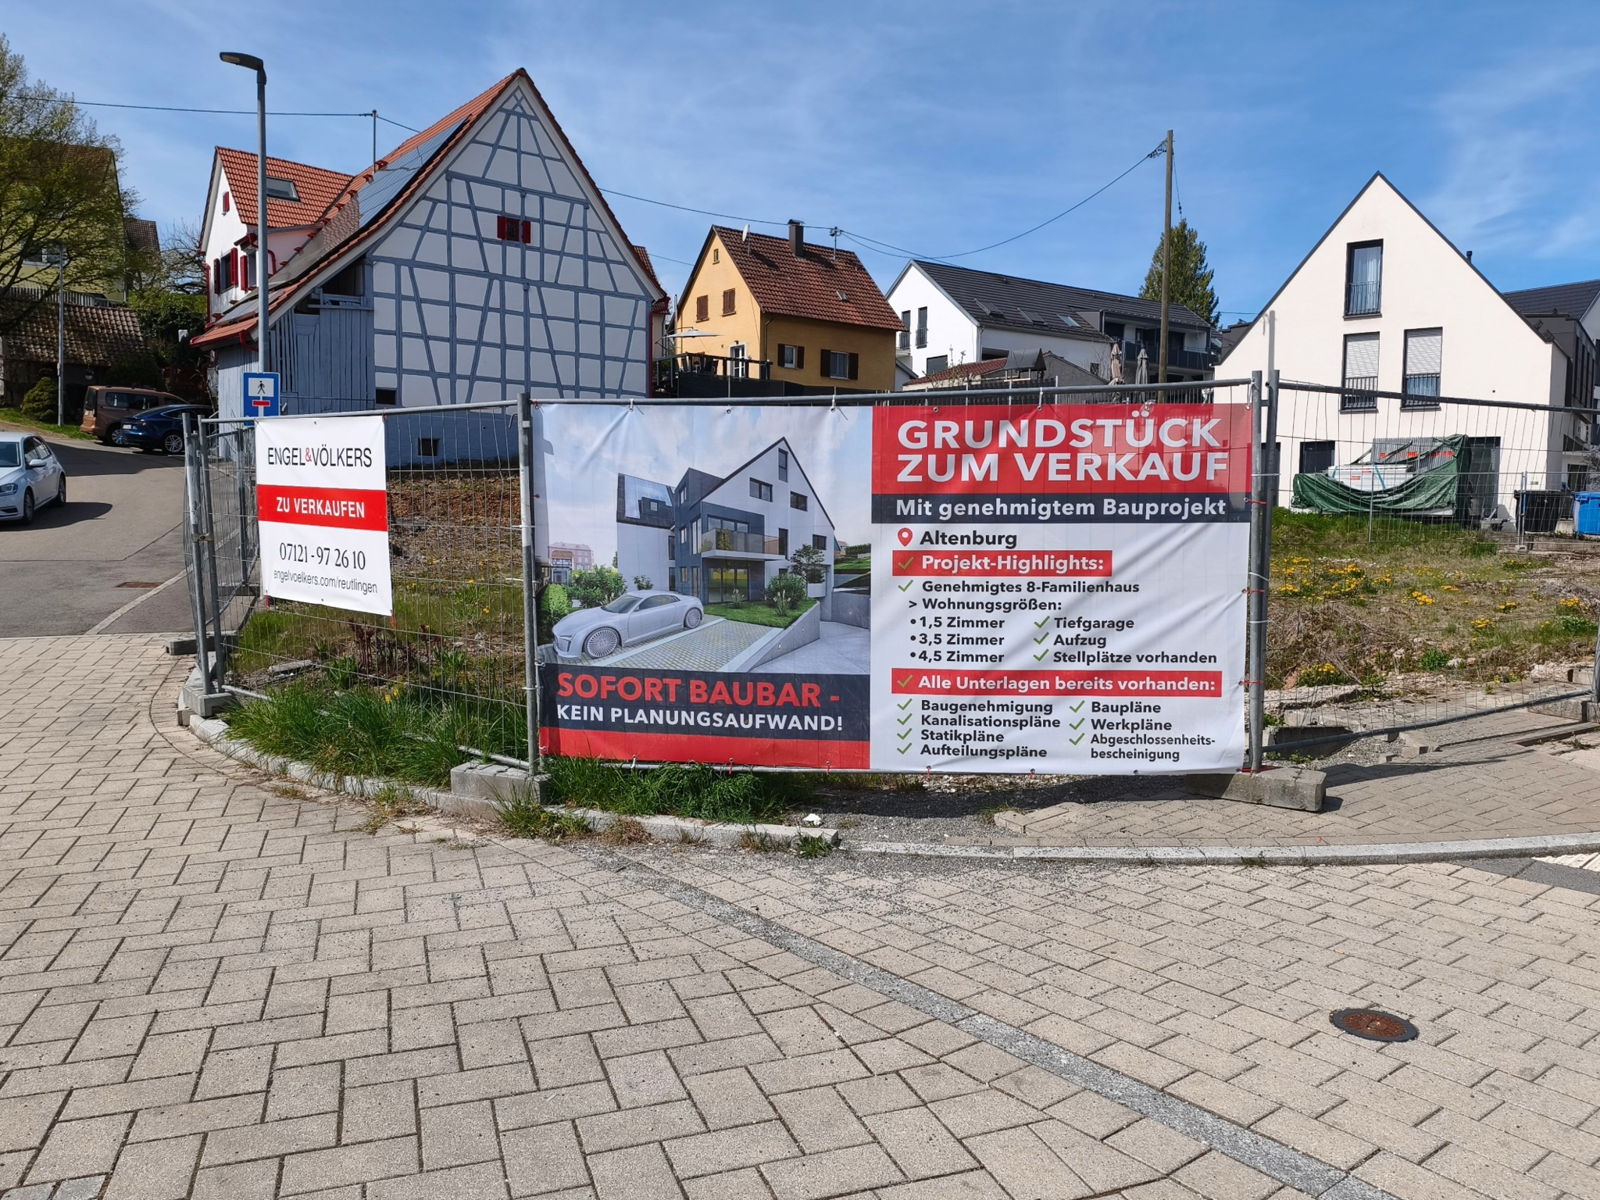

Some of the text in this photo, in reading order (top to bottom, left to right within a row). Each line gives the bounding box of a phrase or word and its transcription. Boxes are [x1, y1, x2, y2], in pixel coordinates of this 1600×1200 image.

[897, 410, 1221, 449] GRUNDSTÜCK
[268, 444, 372, 467] ENGEL&VÖLKERS
[897, 452, 1228, 482] ZUM VERKAUF
[276, 497, 365, 518] ZU VERKAUFEN
[896, 498, 1226, 519] Mit genehmigtem Bauprojekt
[920, 531, 1017, 547] Altenburg
[279, 542, 308, 563] 07121
[335, 549, 349, 568] 26
[353, 551, 366, 570] 10
[922, 555, 1103, 573] Projekt-Highlights:
[273, 569, 378, 595] engelvoelkers.com/reutlingen
[922, 581, 1139, 595] Genehmigtes 8-Familienhaus
[922, 598, 1062, 613] Wohnungsgrößen:
[947, 617, 1005, 628] Zimmer
[1054, 617, 1134, 632] Tiefgarage
[947, 634, 1004, 645] Zimmer
[1053, 634, 1107, 649] Aufzug
[947, 651, 1004, 662] Zimmer
[1053, 651, 1217, 666] Stellplätze vorhanden
[557, 673, 681, 702] SOFORT
[689, 680, 820, 707] BAUBAR
[919, 676, 1215, 693] Alle Unterlagen bereits vorhanden:
[921, 701, 1053, 715] Baugenehmigung
[1091, 702, 1161, 715] Baupläne
[557, 704, 843, 731] KEIN PLANUNGSAUFWAND!
[921, 715, 1061, 730] Kanalisationspläne
[1091, 719, 1172, 732] Werkpläne
[921, 731, 1004, 744] Statikpläne
[1090, 734, 1216, 748] Abgeschlossenheits-
[920, 745, 1047, 759] Aufteilungspläne
[1091, 748, 1180, 762] bescheinigung
